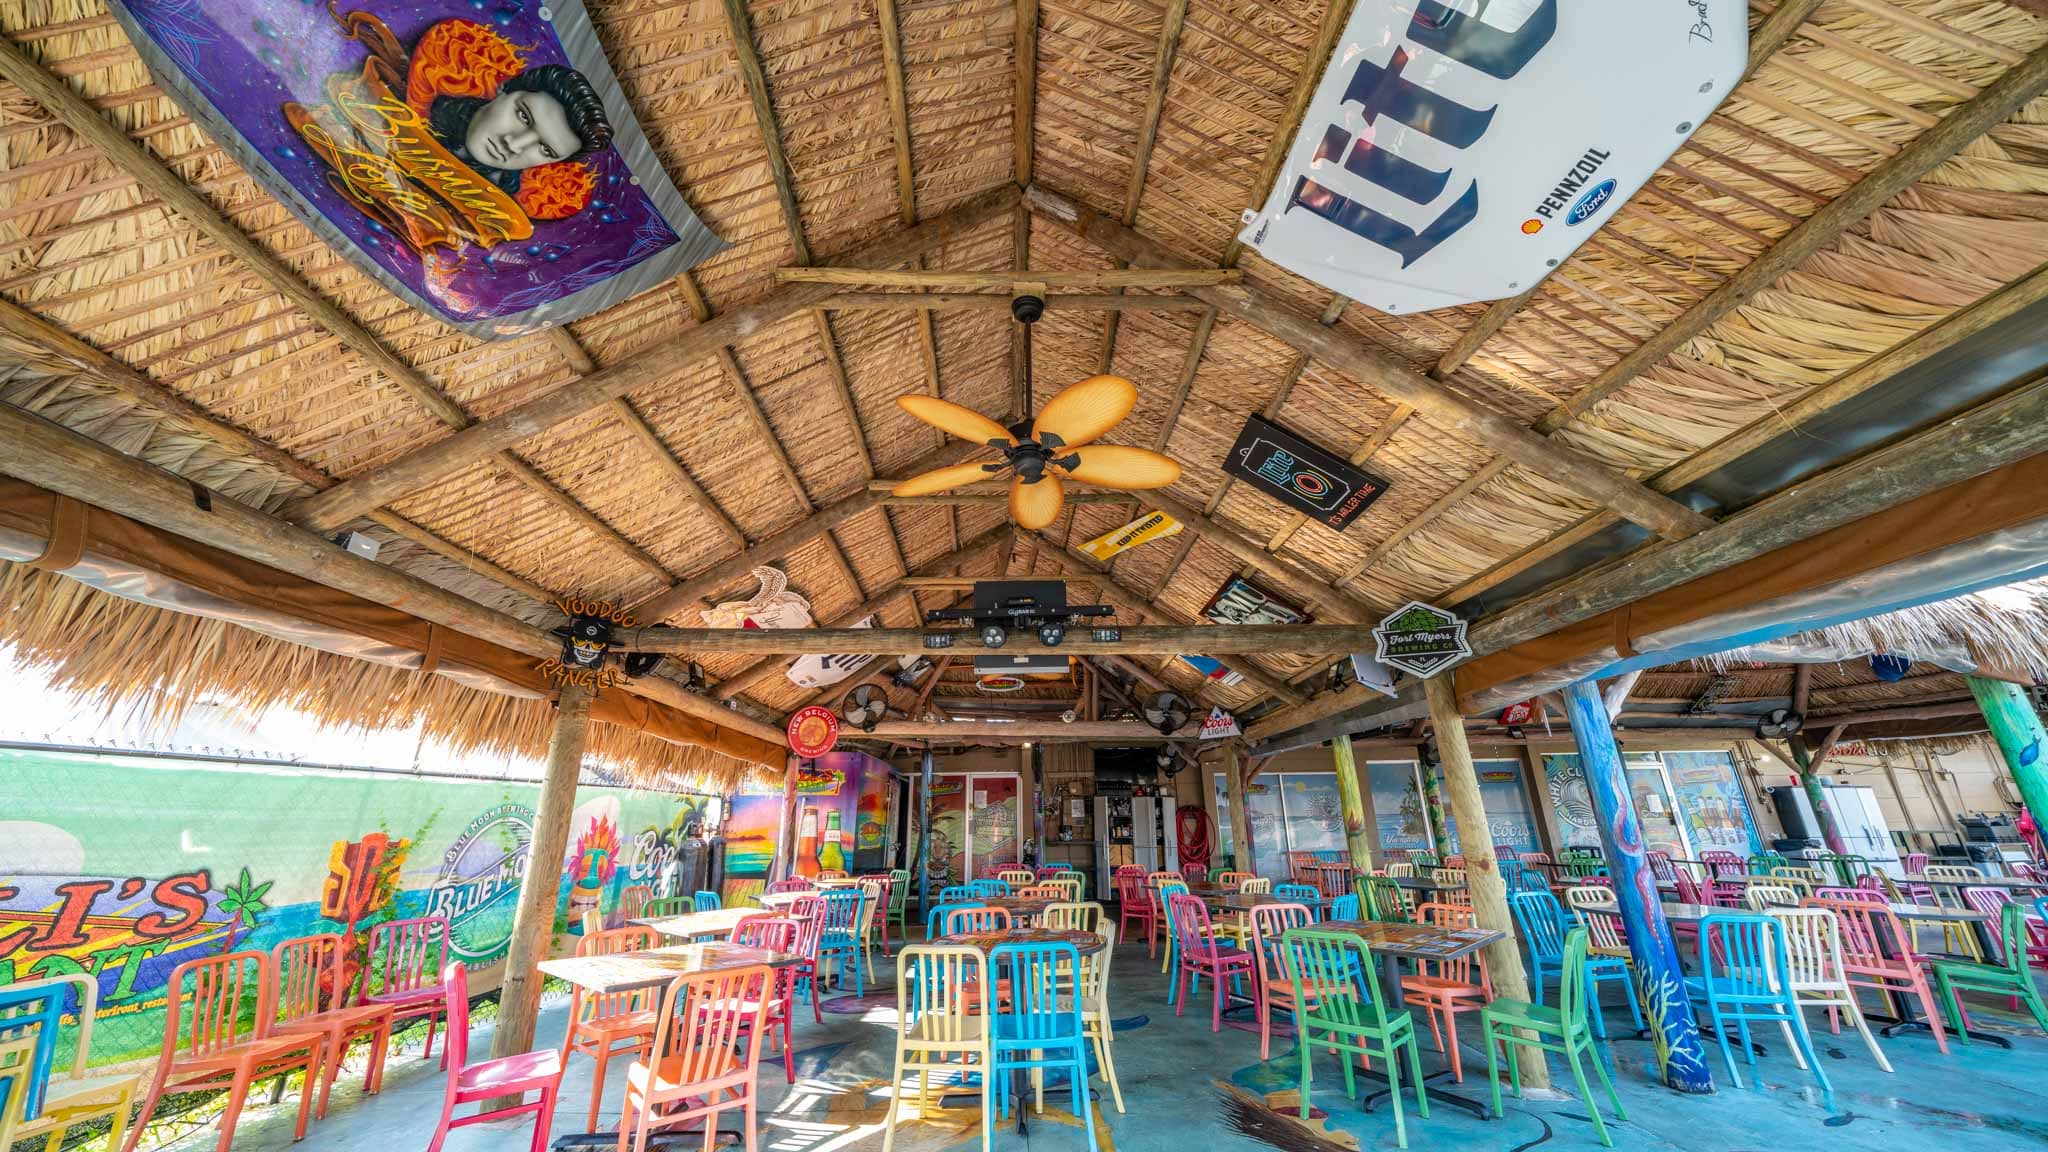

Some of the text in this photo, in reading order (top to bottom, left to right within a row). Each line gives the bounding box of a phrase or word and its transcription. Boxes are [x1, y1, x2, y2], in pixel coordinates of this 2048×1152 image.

[301, 123, 445, 232] Love
[1535, 147, 1611, 219] PENNZOIL
[1574, 187, 1609, 219] Ford
[554, 596, 638, 628] VOODOO
[1390, 632, 1453, 646] Fort Myers
[1390, 643, 1439, 654] BREWING
[534, 656, 626, 690] RANGER
[791, 709, 836, 735] NEW BELGIUM
[1204, 715, 1233, 729] Coors
[1207, 727, 1230, 736] LIGHT
[1550, 767, 1585, 808] WHITE CL
[445, 832, 470, 864] BLUE
[470, 810, 496, 833] MOON
[1490, 821, 1530, 838] Coors
[428, 852, 530, 923] BLUE MO
